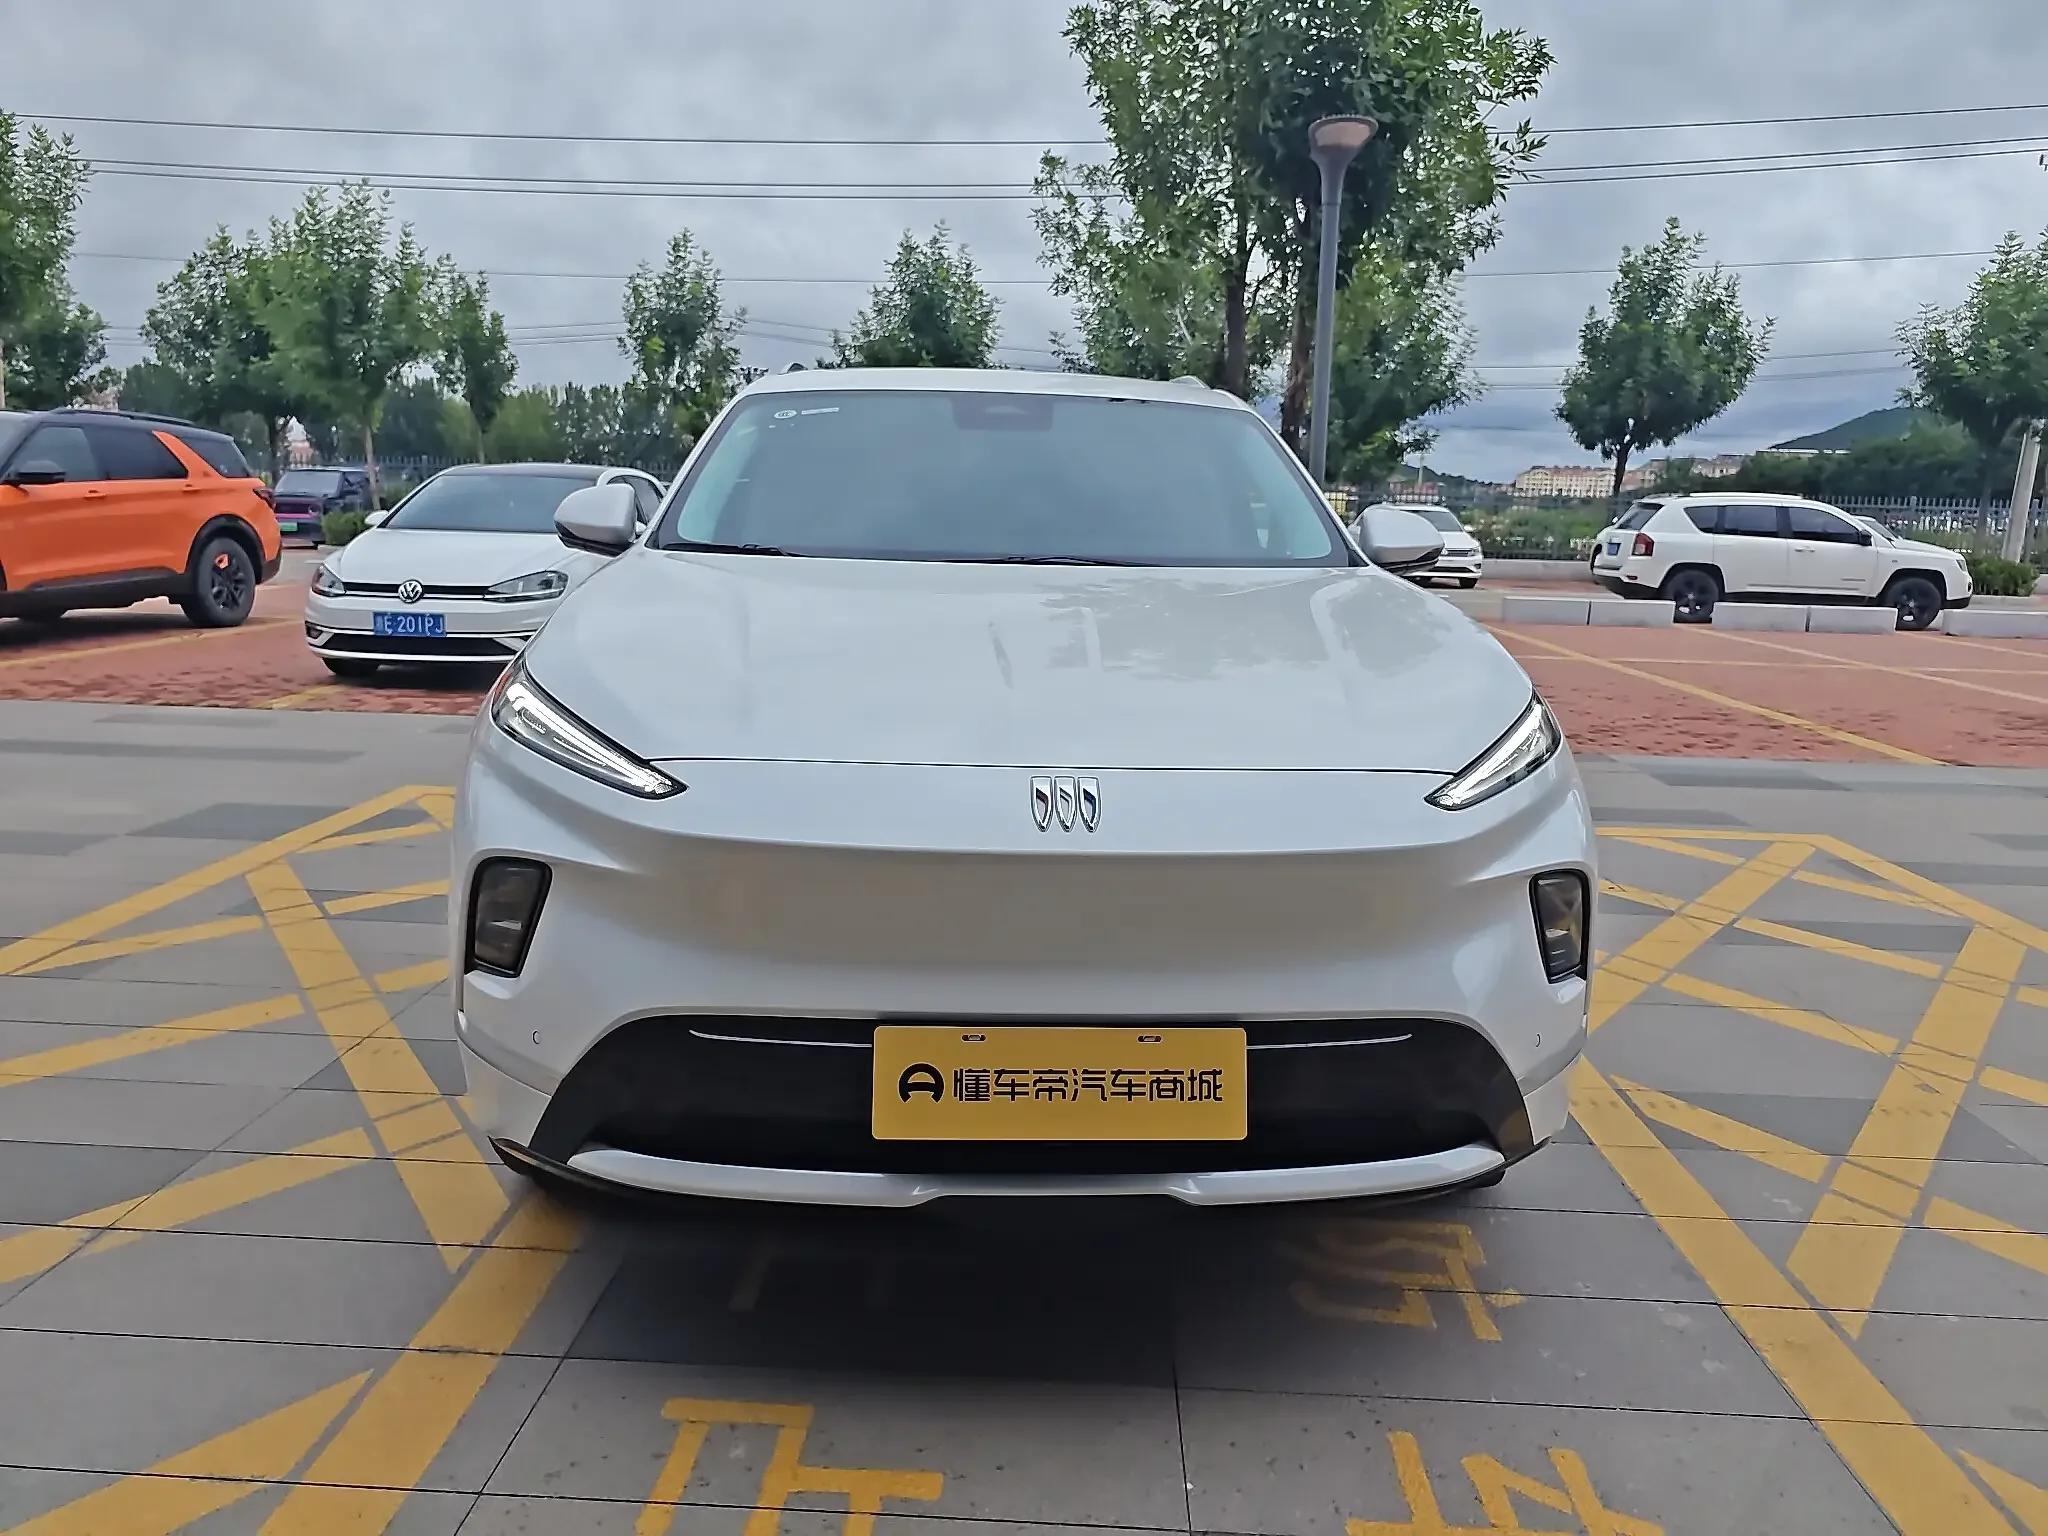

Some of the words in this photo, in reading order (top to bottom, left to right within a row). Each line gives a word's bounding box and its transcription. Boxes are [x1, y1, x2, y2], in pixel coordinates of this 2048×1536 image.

[953, 1068, 1223, 1101] 懂车帝汽车商城
